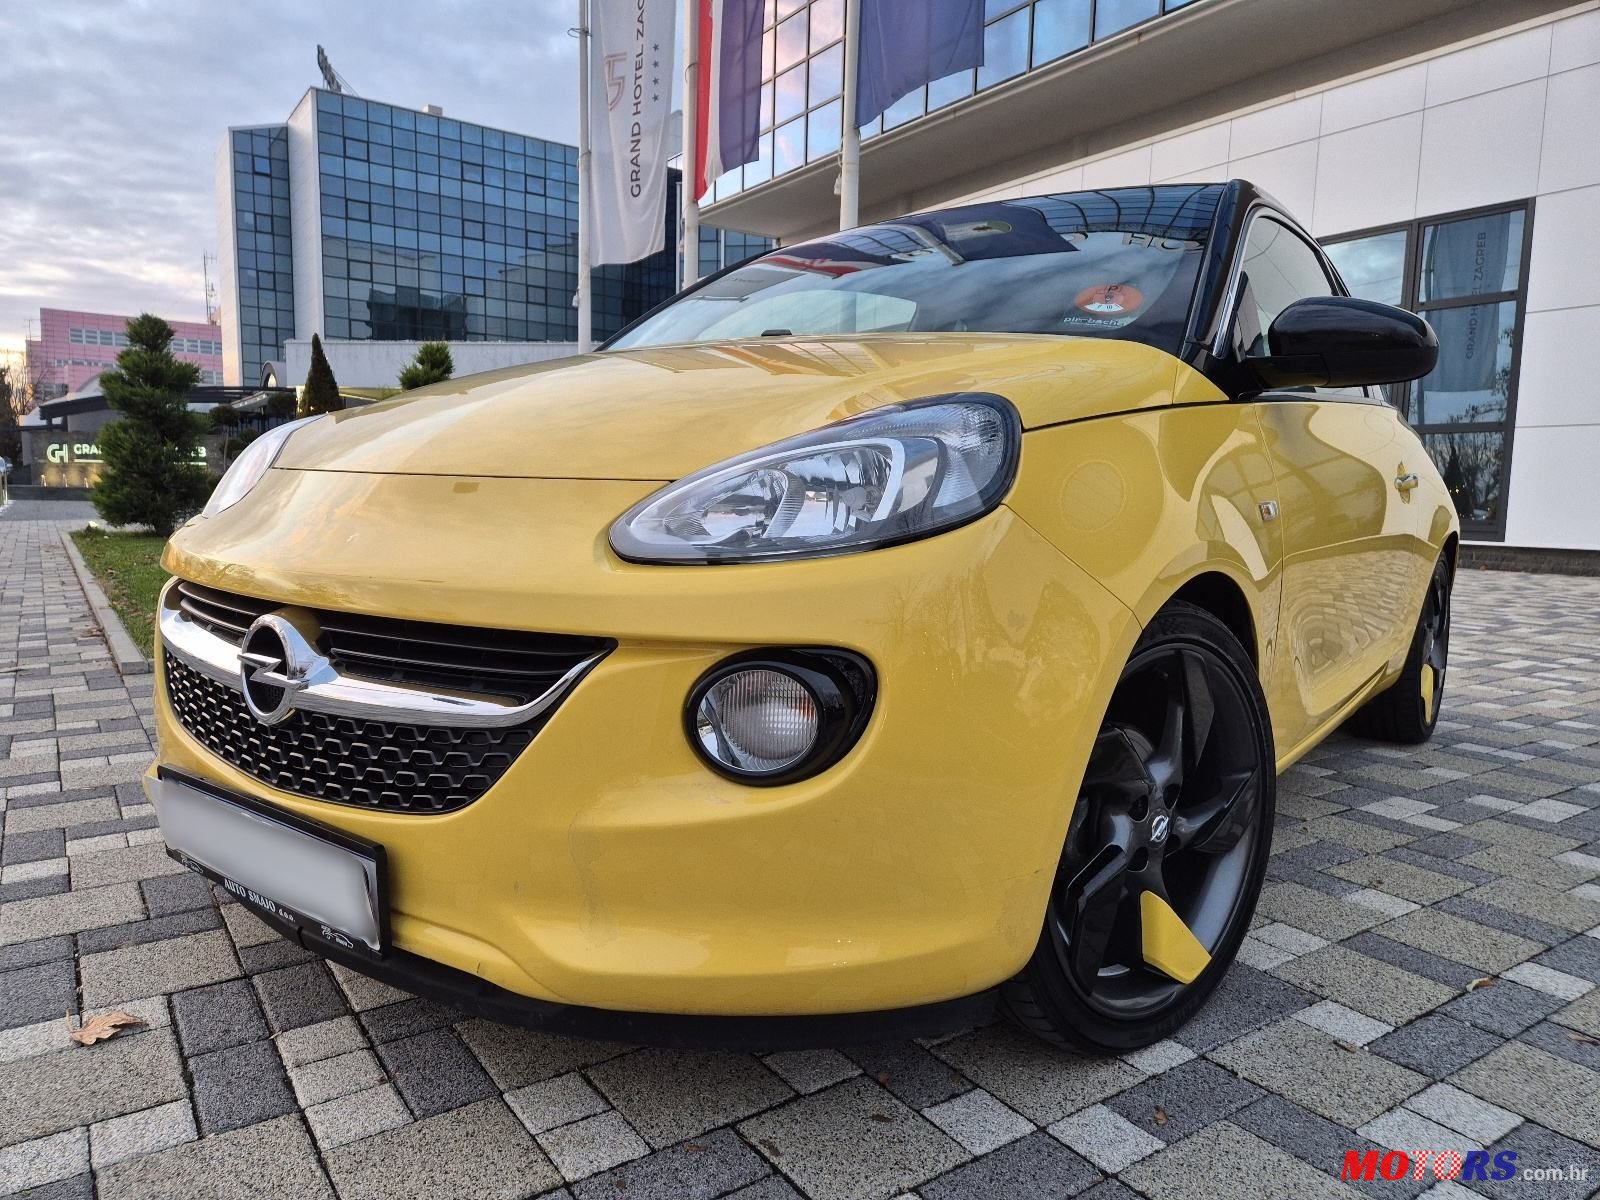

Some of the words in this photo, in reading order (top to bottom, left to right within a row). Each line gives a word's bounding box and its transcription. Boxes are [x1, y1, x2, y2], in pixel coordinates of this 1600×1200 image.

[632, 44, 645, 116] HOTEL
[630, 121, 642, 198] GRAND
[1465, 317, 1478, 360] GRAND
[1473, 231, 1487, 281] ZAGREB
[224, 878, 247, 898] AUTO
[247, 889, 276, 913] SMAJO
